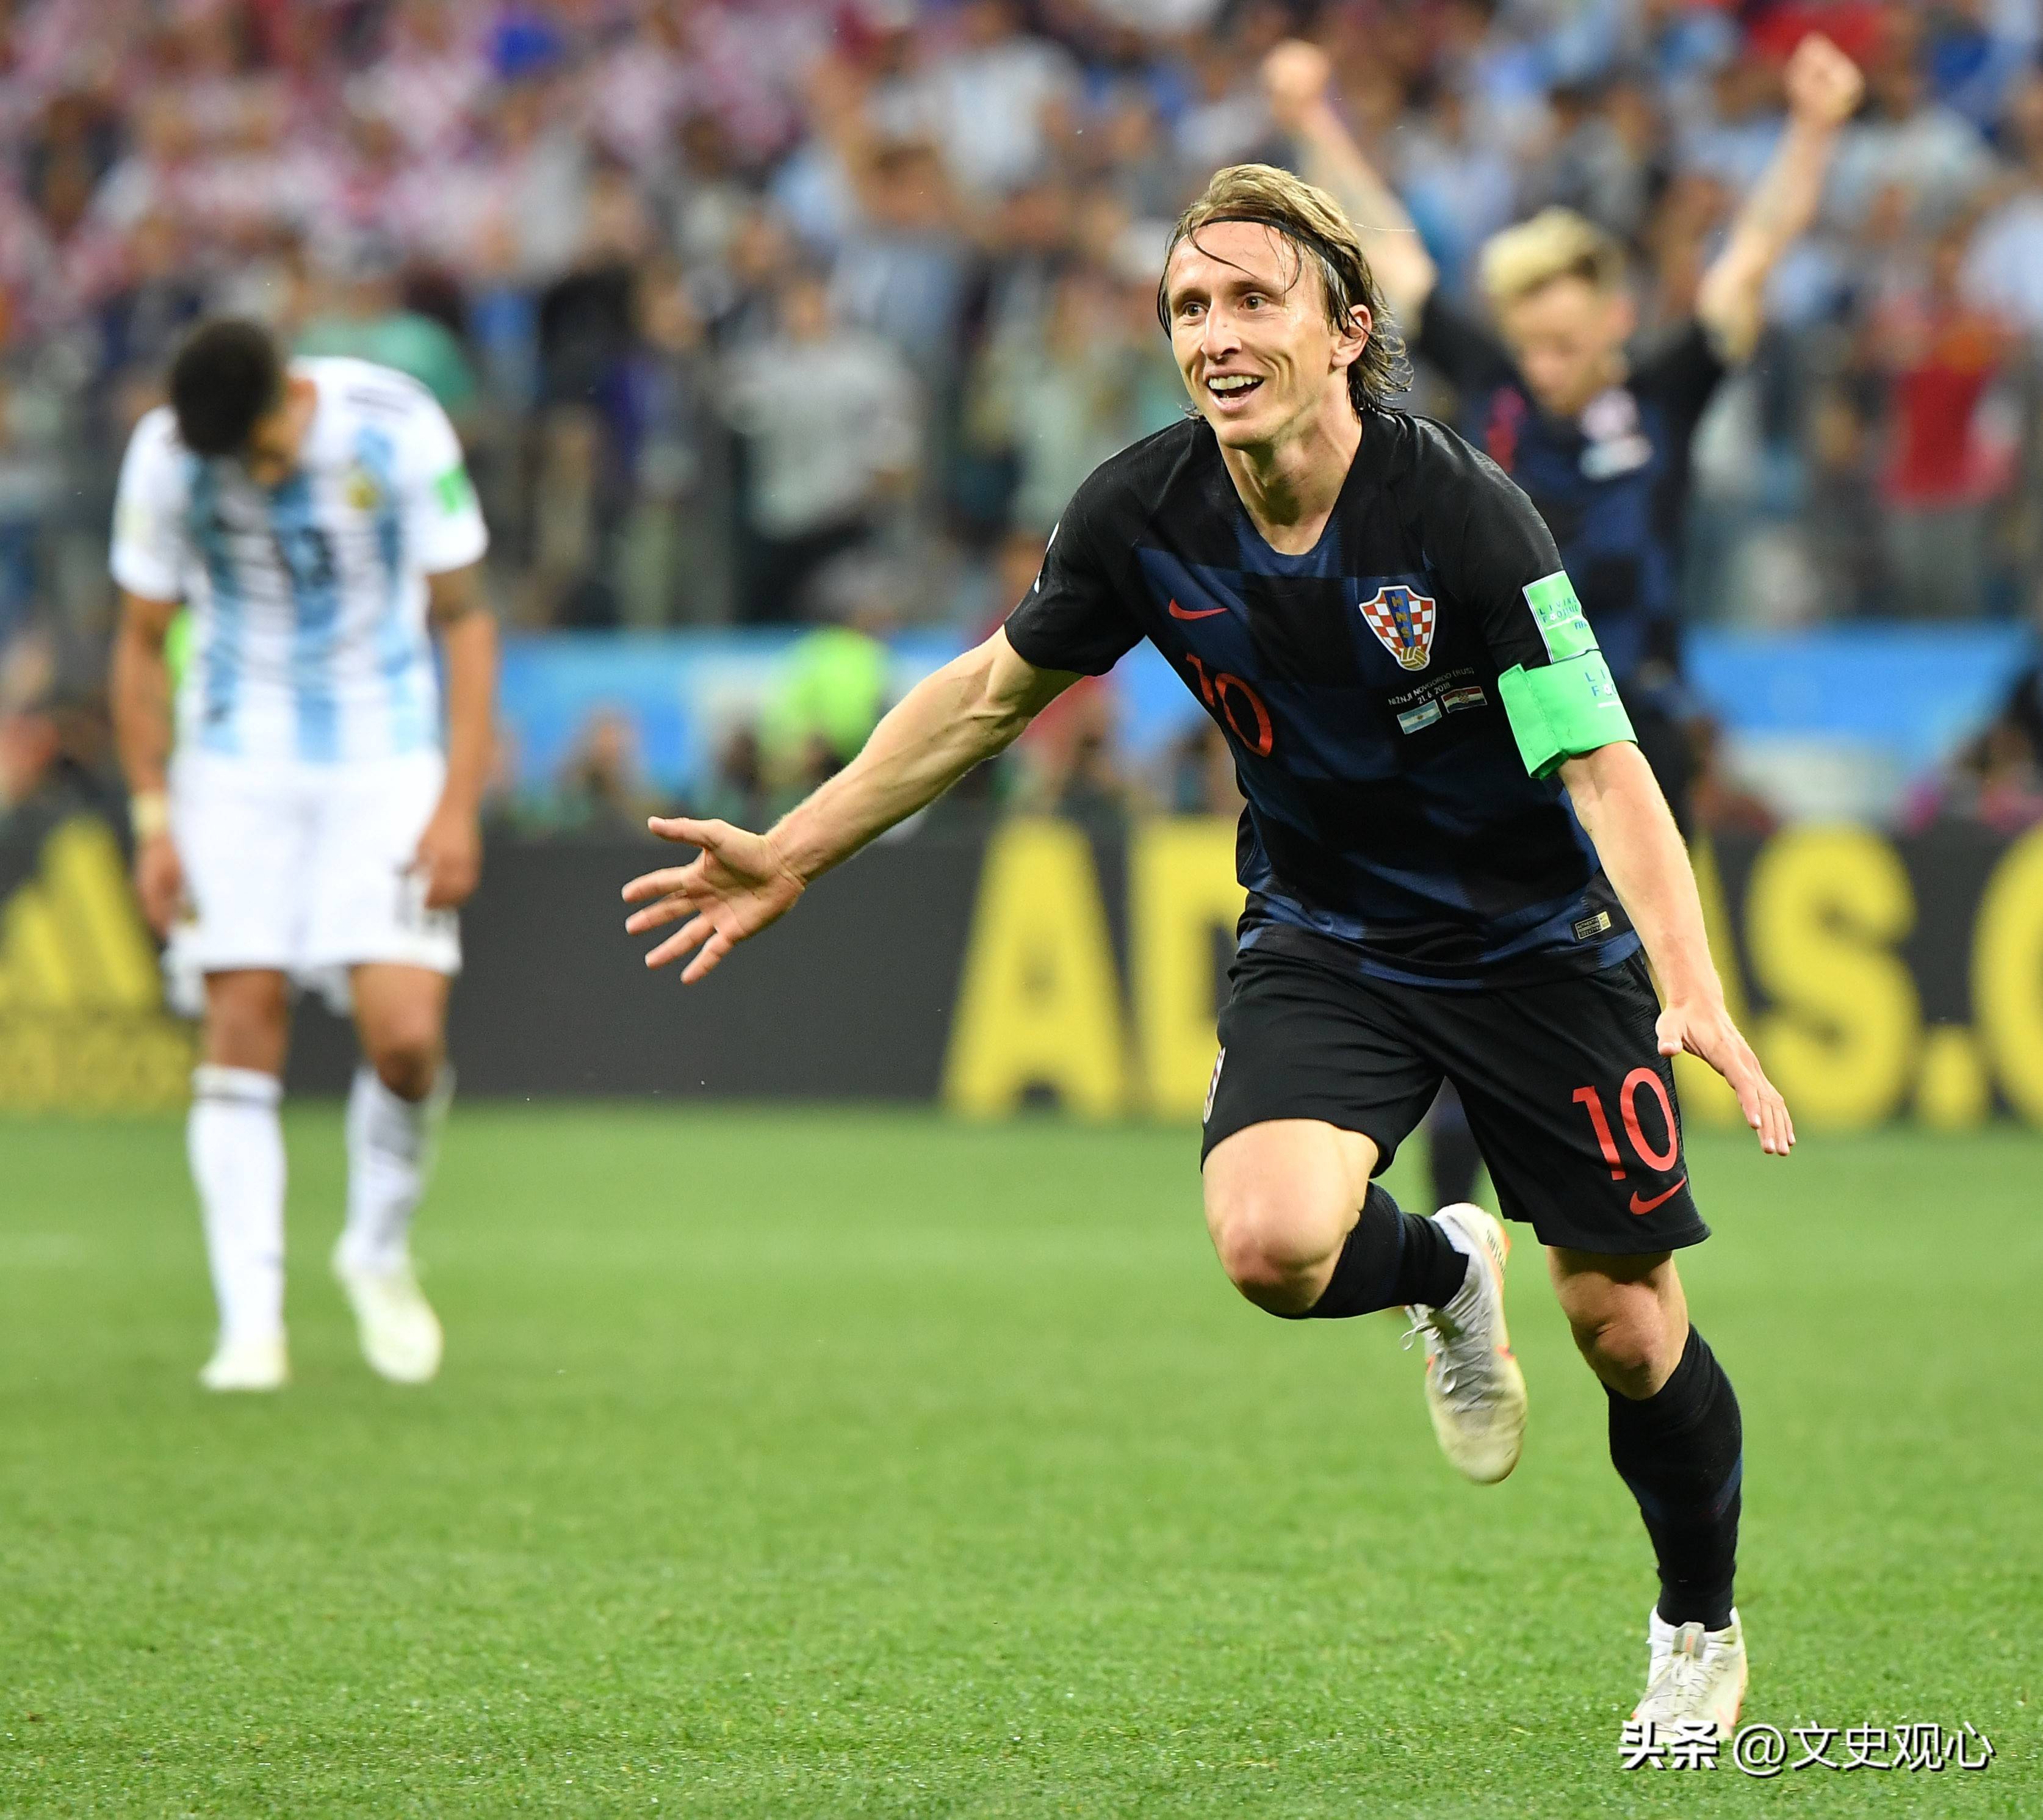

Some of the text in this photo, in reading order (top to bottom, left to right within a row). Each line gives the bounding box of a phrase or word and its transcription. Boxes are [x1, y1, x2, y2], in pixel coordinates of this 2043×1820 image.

[1391, 595, 1410, 638] HNS
[1185, 652, 1274, 758] 10
[1573, 1067, 1678, 1181] 10
